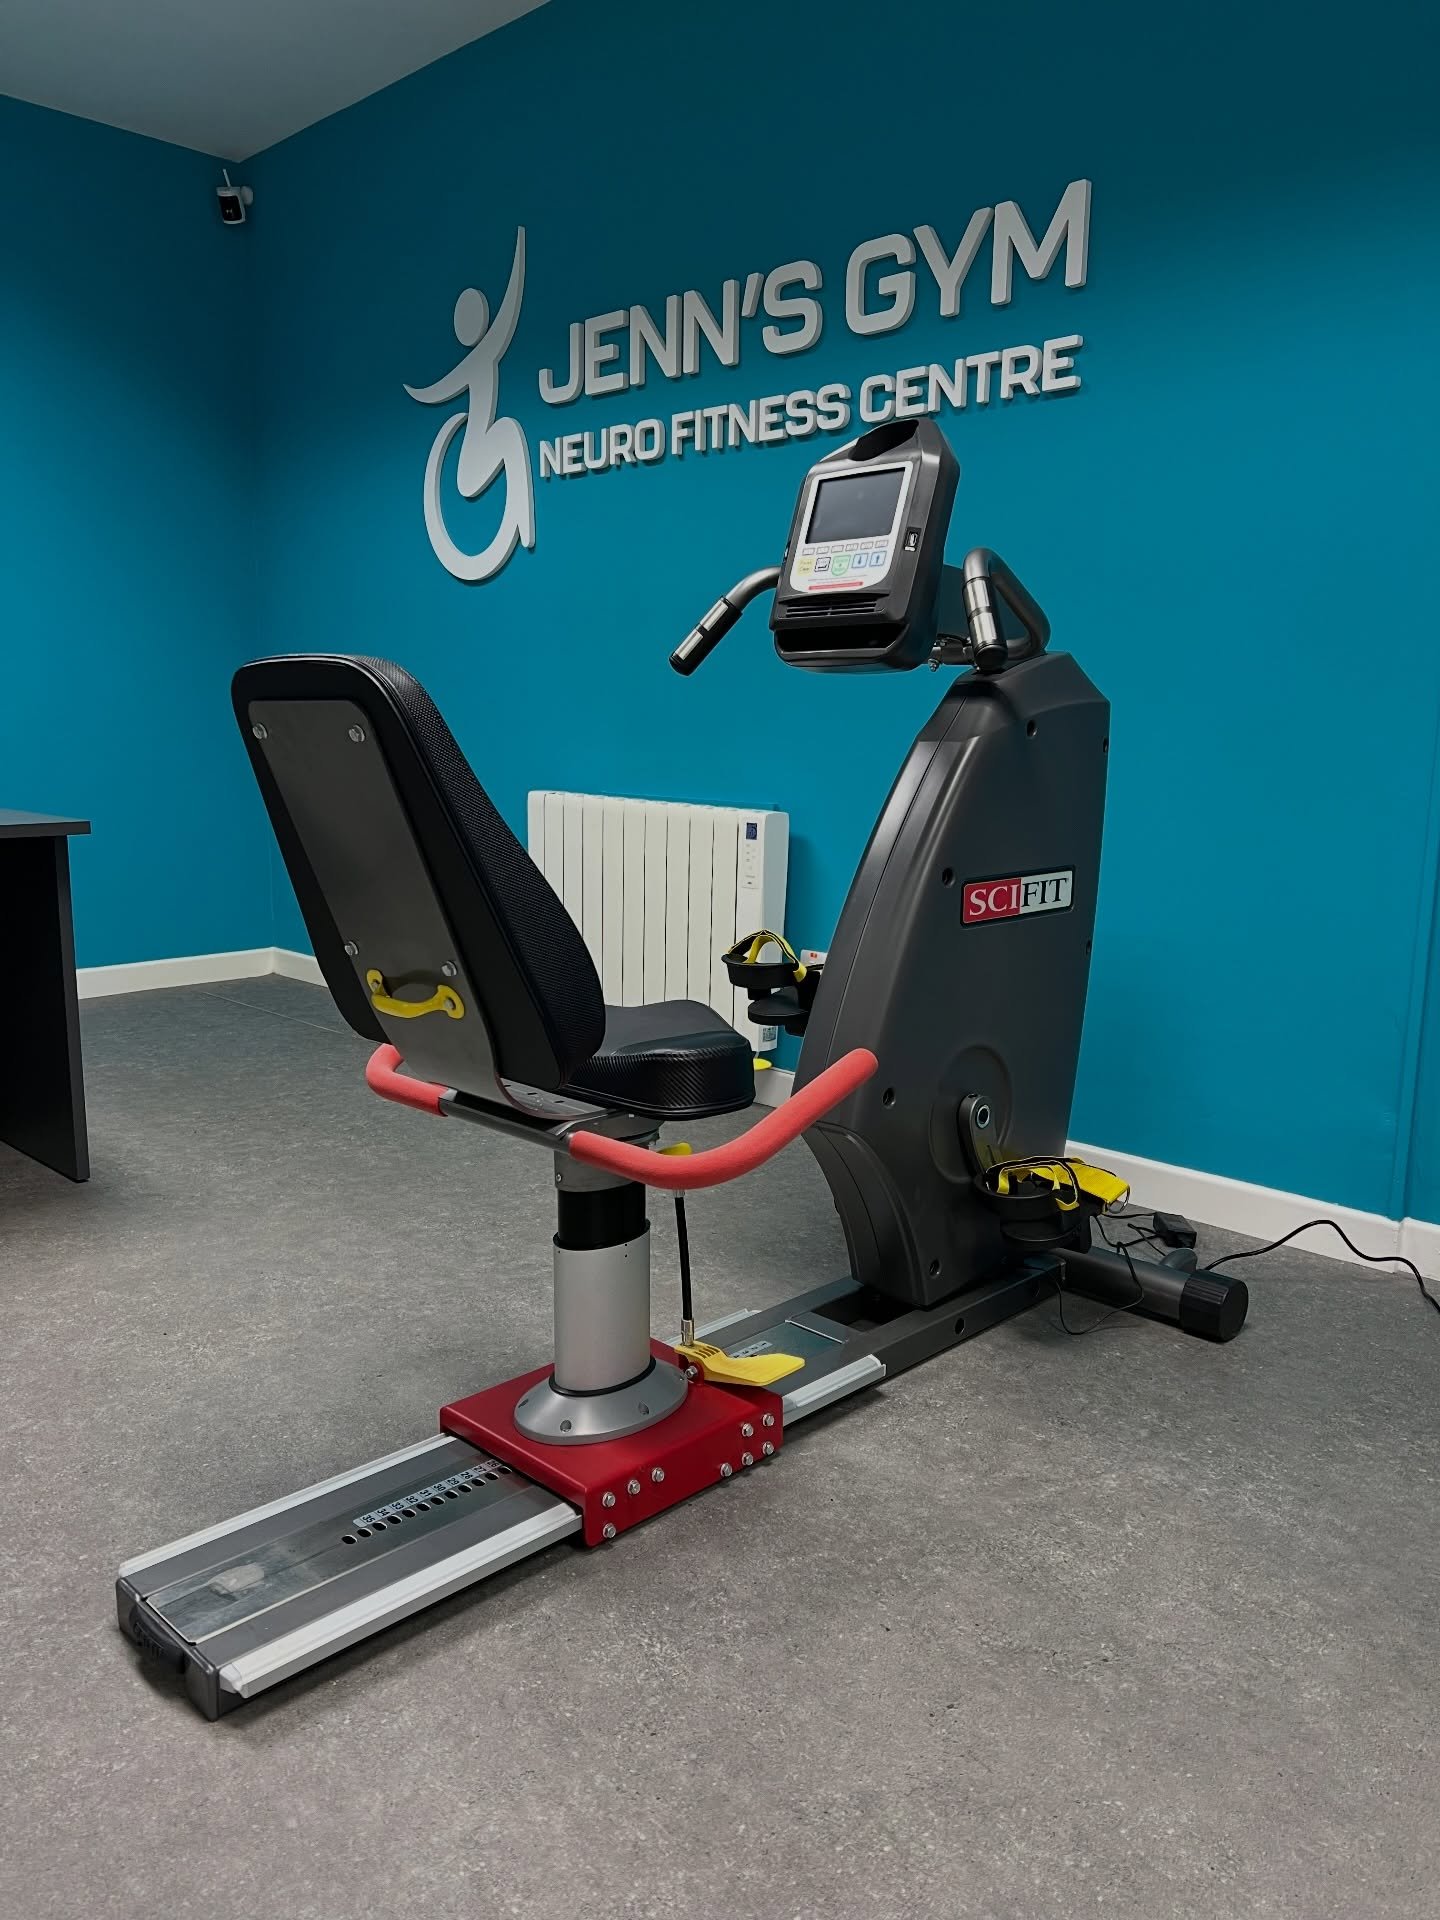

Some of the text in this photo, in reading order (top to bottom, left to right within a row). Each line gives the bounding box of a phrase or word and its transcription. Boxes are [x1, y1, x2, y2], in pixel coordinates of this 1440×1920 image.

[538, 179, 1092, 404] JENN'S GYM
[539, 334, 1084, 478] NEURO FITNESS CENTRE
[969, 877, 1068, 916] SCIFIT
[419, 1489, 432, 1498] 31
[405, 1495, 419, 1504] 32
[391, 1501, 405, 1510] 33
[377, 1508, 391, 1517] 34
[362, 1514, 376, 1523] 35
